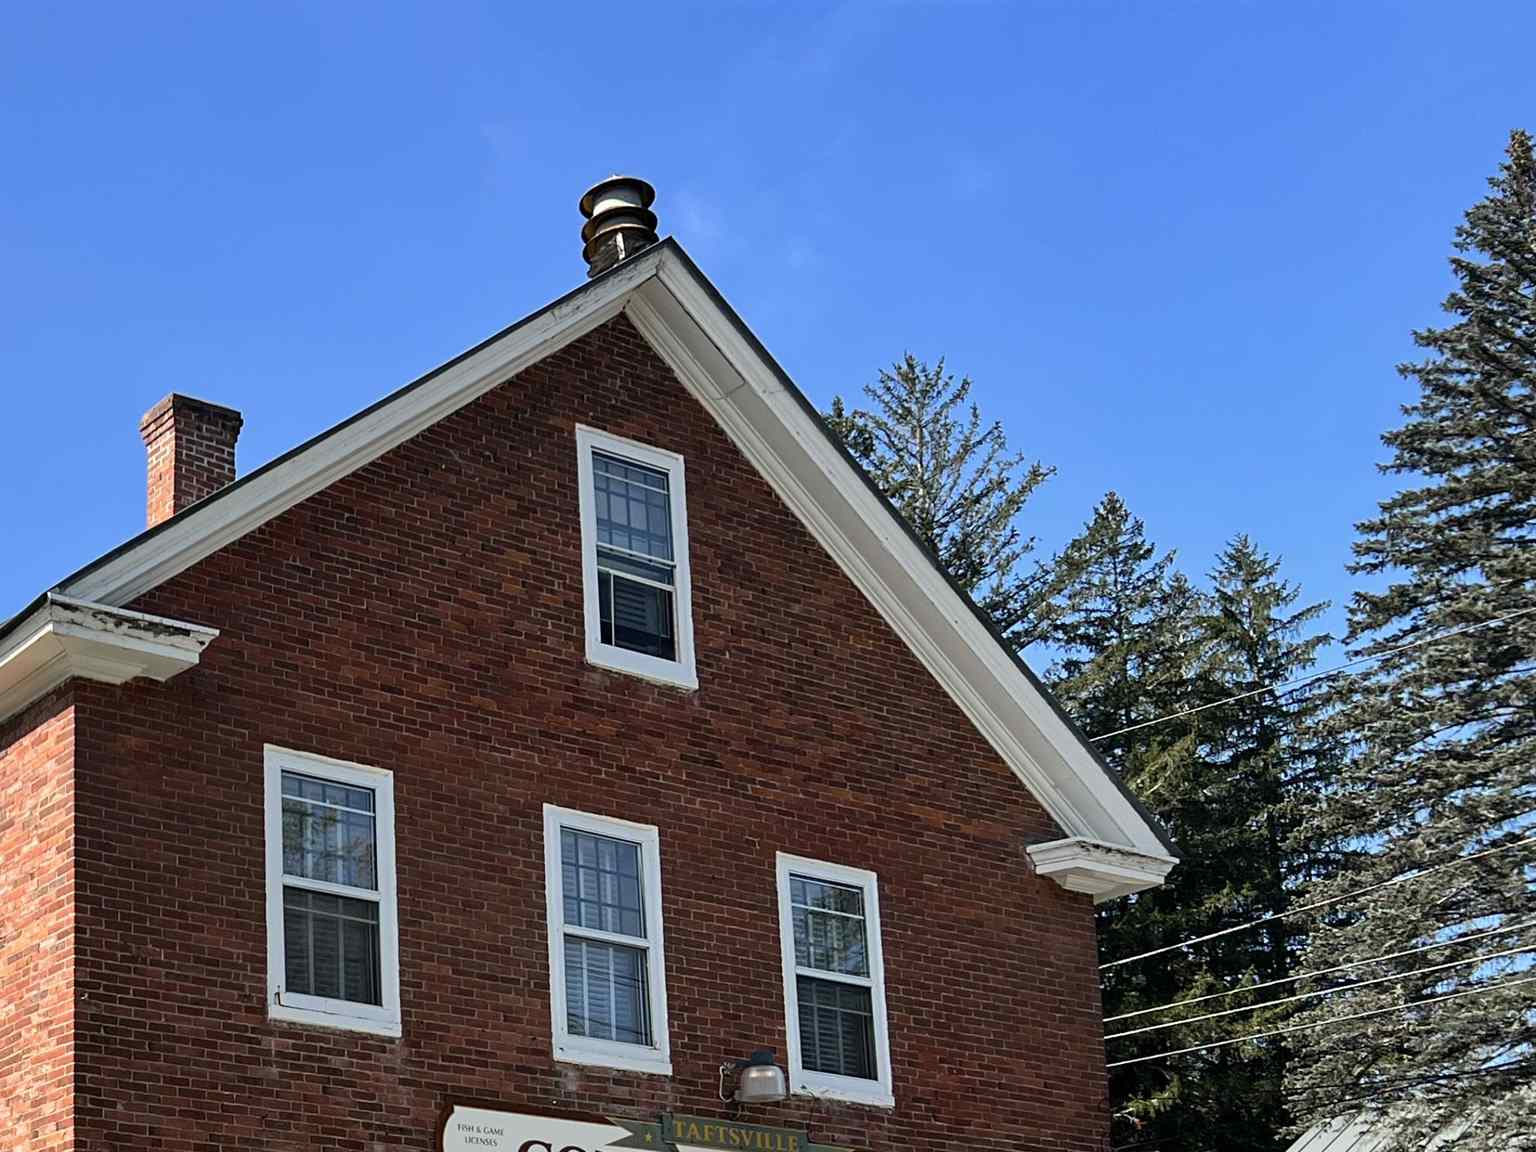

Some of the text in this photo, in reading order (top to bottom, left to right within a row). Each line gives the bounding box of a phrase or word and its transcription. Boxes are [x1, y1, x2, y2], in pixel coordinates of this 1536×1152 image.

[457, 1123, 474, 1133] FISH
[483, 1126, 504, 1136] GAME
[674, 1119, 800, 1152] TAFTSVILLE
[464, 1136, 498, 1146] LICENSES
